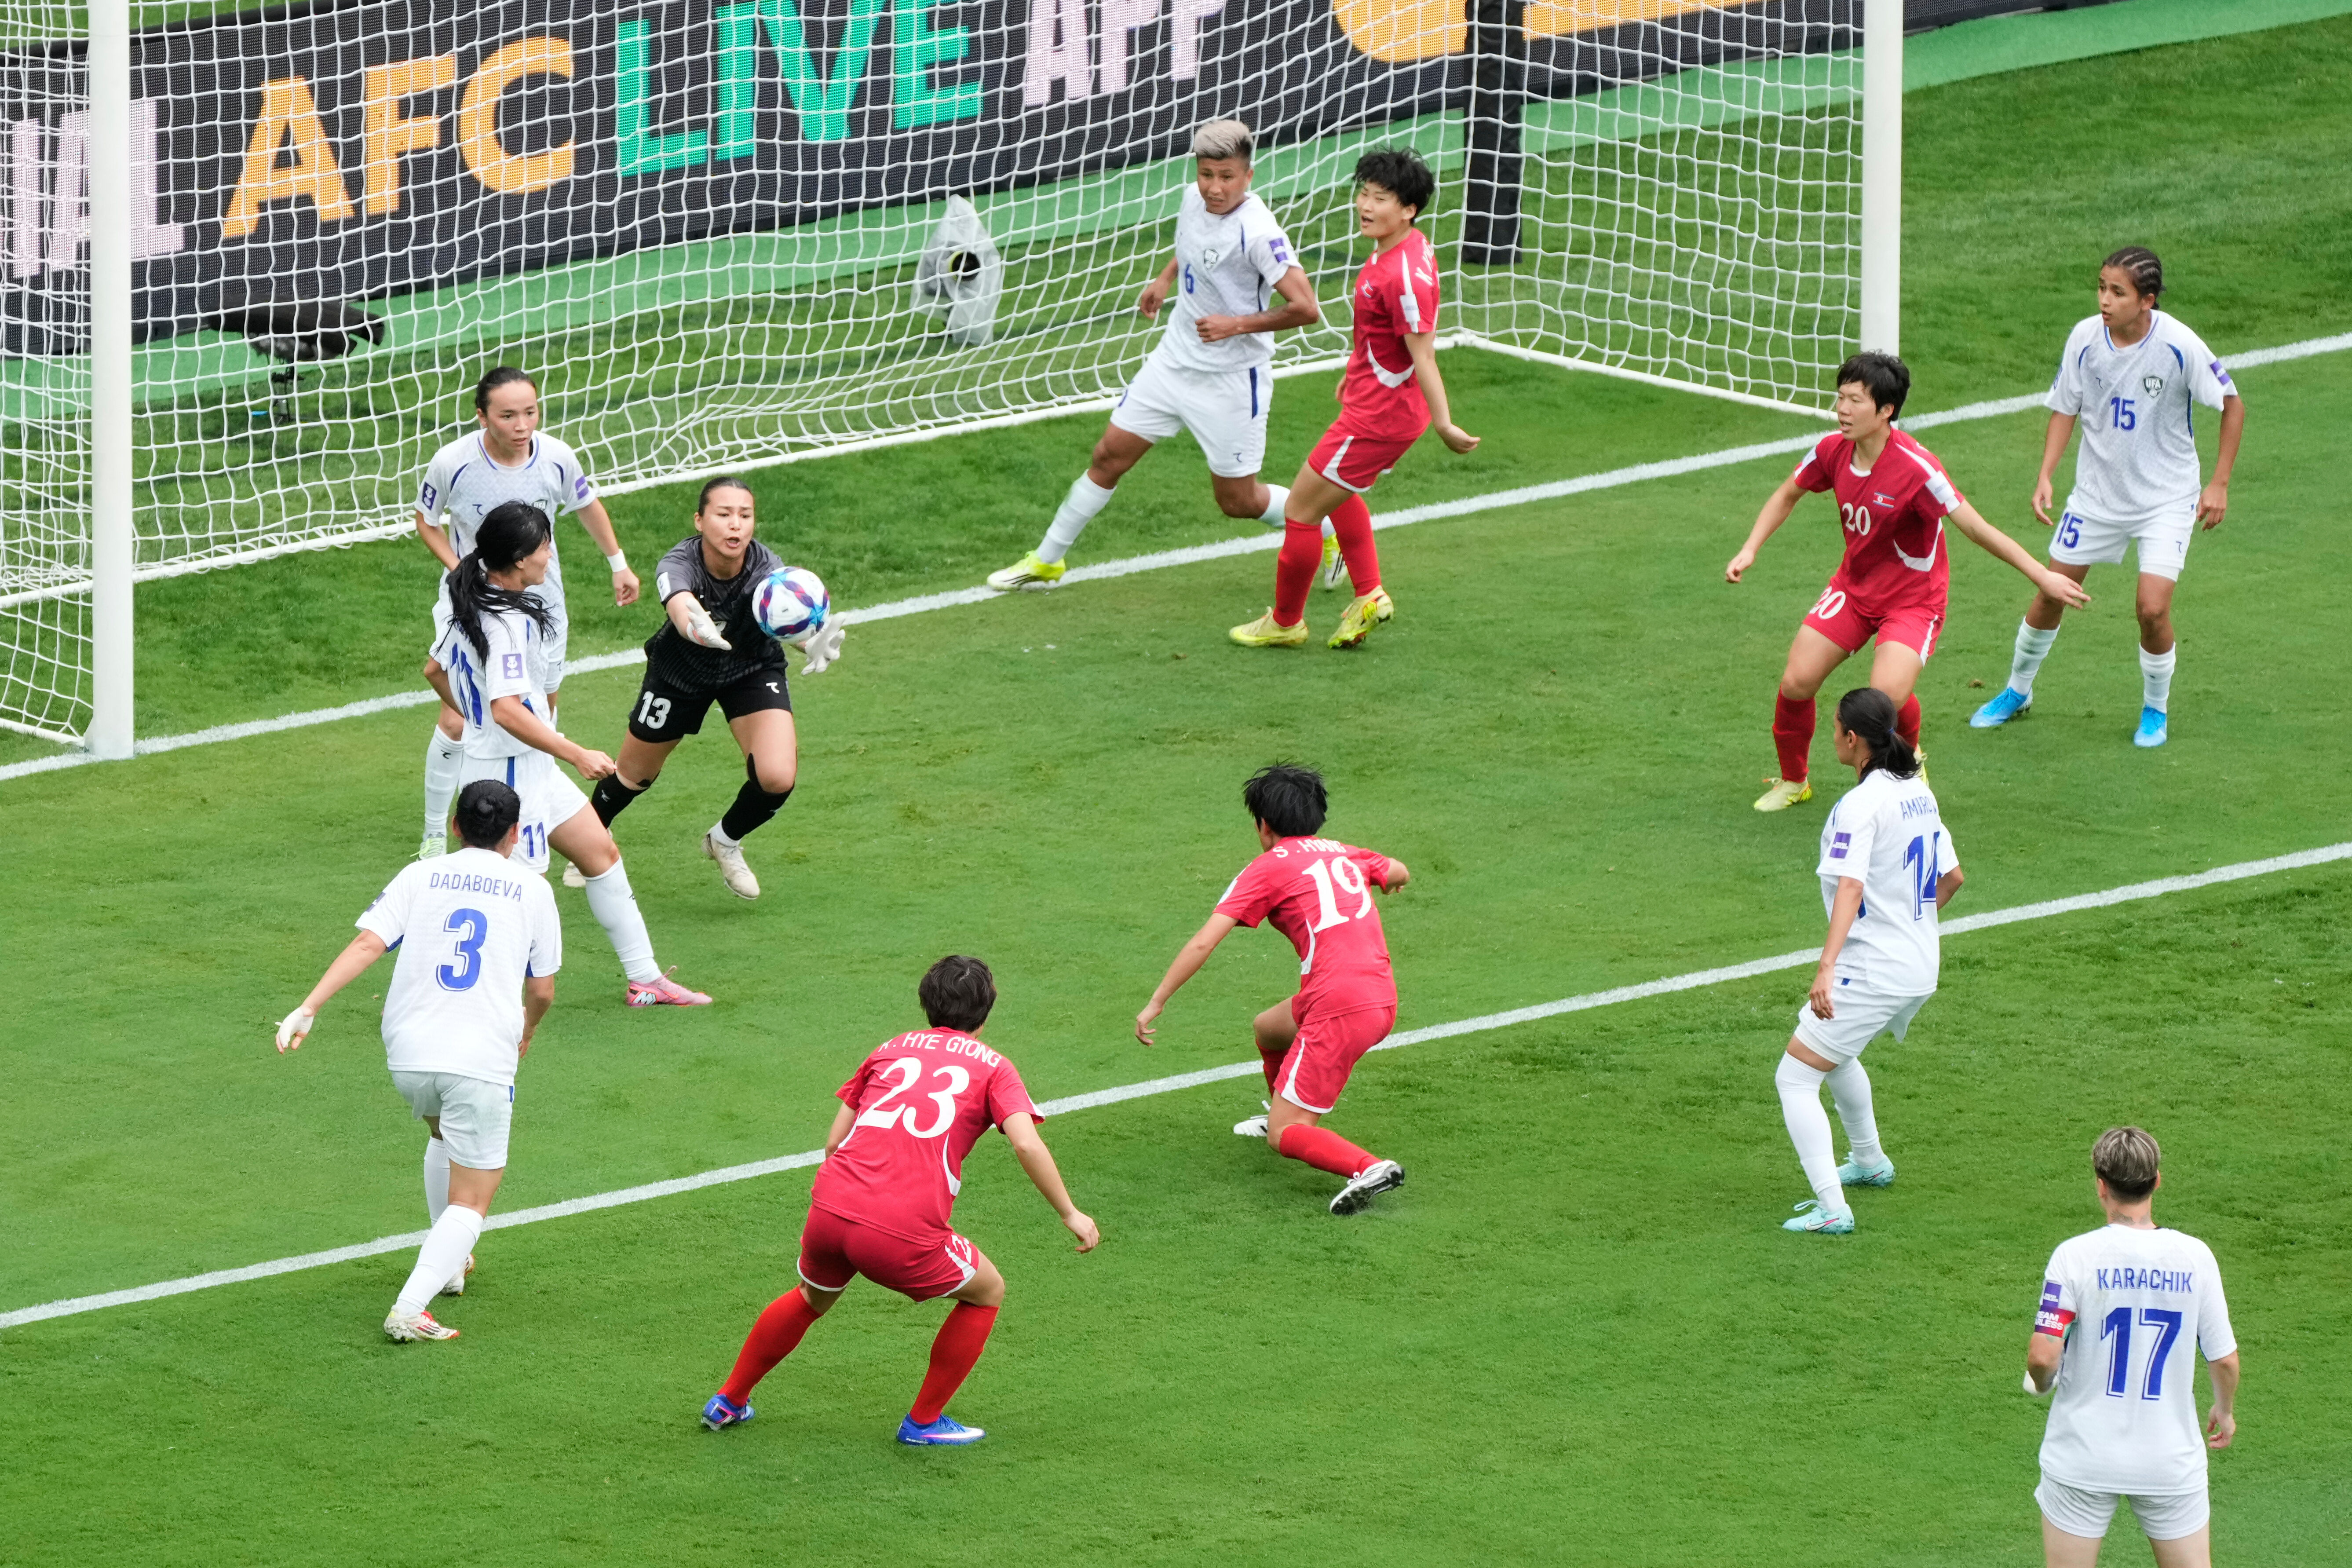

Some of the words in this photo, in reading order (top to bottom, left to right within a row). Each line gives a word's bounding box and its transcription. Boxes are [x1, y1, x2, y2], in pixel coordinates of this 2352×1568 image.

[223, 37, 575, 238] AFC
[617, 0, 983, 176] LIVE
[1025, 0, 1225, 106] APP
[1184, 264, 1194, 294] 6
[2111, 397, 2136, 431] 15
[1842, 502, 1871, 536] 20
[2056, 512, 2084, 548] 15
[1809, 586, 1846, 620] 20
[449, 643, 482, 730] 11
[638, 691, 672, 730] 13
[521, 822, 546, 859] 11
[429, 872, 522, 903] DADABOEVA
[1301, 856, 1372, 933] 19
[435, 908, 488, 992] 3
[902, 1032, 944, 1050] HYE
[946, 1036, 1002, 1068] GYONG
[856, 1057, 970, 1139] 23
[2096, 1268, 2193, 1294] KARACHIK
[2100, 1307, 2183, 1401] 17
